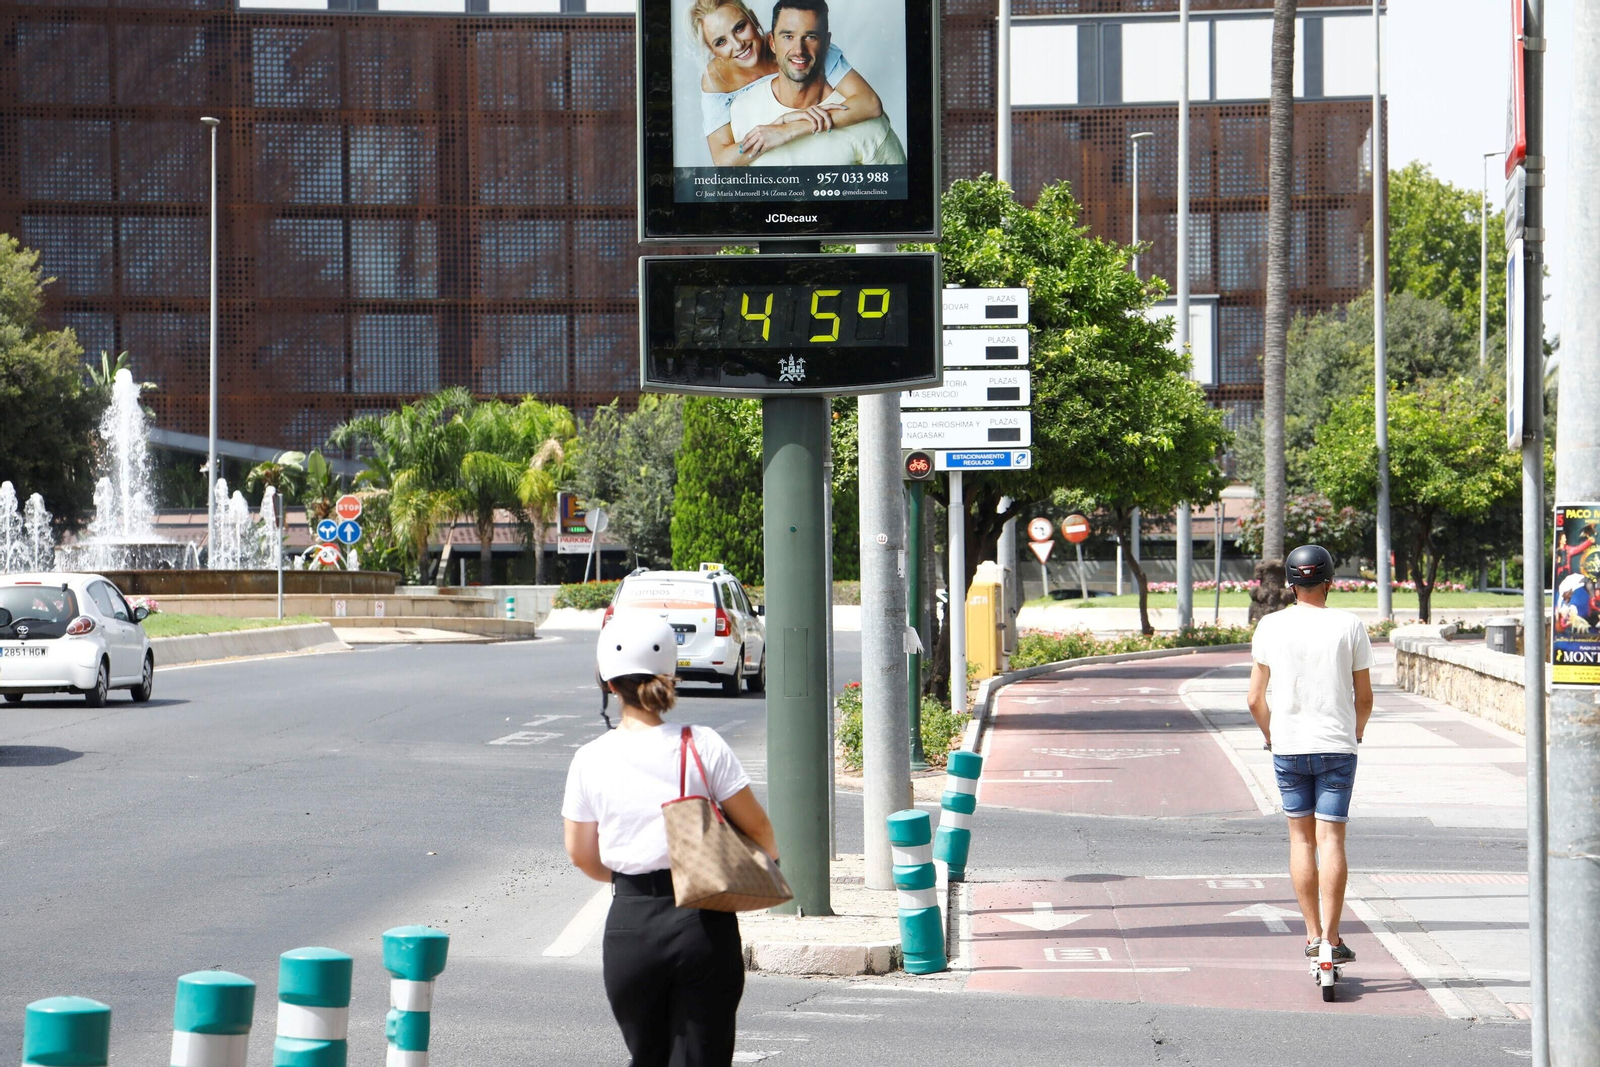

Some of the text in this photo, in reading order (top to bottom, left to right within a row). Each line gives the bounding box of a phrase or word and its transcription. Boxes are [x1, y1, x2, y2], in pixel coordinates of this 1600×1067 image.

[693, 172, 889, 185] medicanclinics.com 957 033 988
[704, 190, 716, 198] José
[761, 189, 770, 197] 34
[770, 189, 788, 198] (Zona
[788, 189, 806, 198] Zoco)
[842, 188, 888, 197] @medicanclinics
[765, 213, 818, 223] JCDecaux
[987, 295, 1016, 303] PLAZAS
[988, 336, 1017, 344] PLAZAS
[989, 377, 1018, 385] PLAZAS
[975, 420, 980, 428] Y
[1566, 509, 1592, 519] PACO
[4, 648, 46, 657] 2851 HGW
